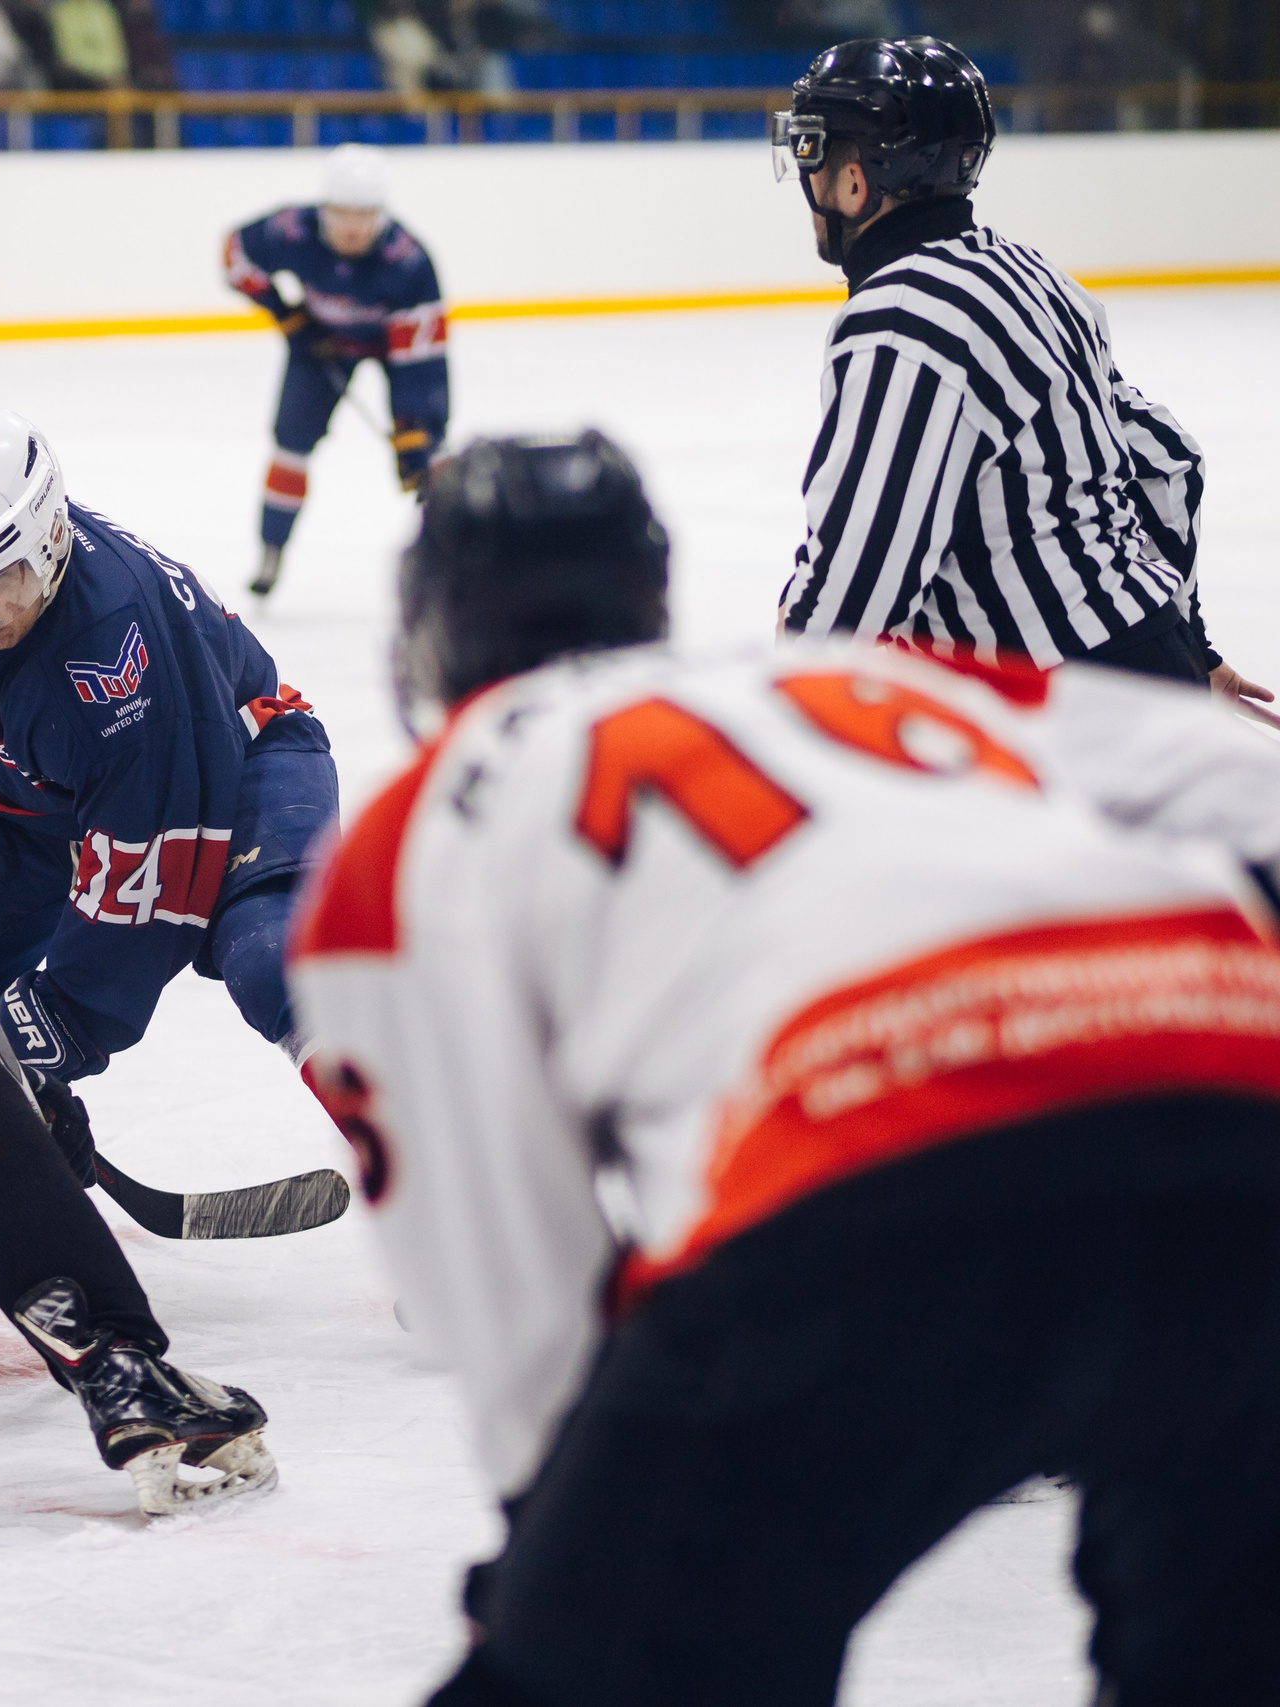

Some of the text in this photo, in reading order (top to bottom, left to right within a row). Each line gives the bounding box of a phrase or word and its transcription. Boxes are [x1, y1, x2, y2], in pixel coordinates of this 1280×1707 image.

[34, 474, 55, 513] BAUER
[115, 697, 142, 718] MININ
[101, 717, 132, 738] UNITED
[75, 830, 162, 926] 14
[4, 977, 47, 1051] UER
